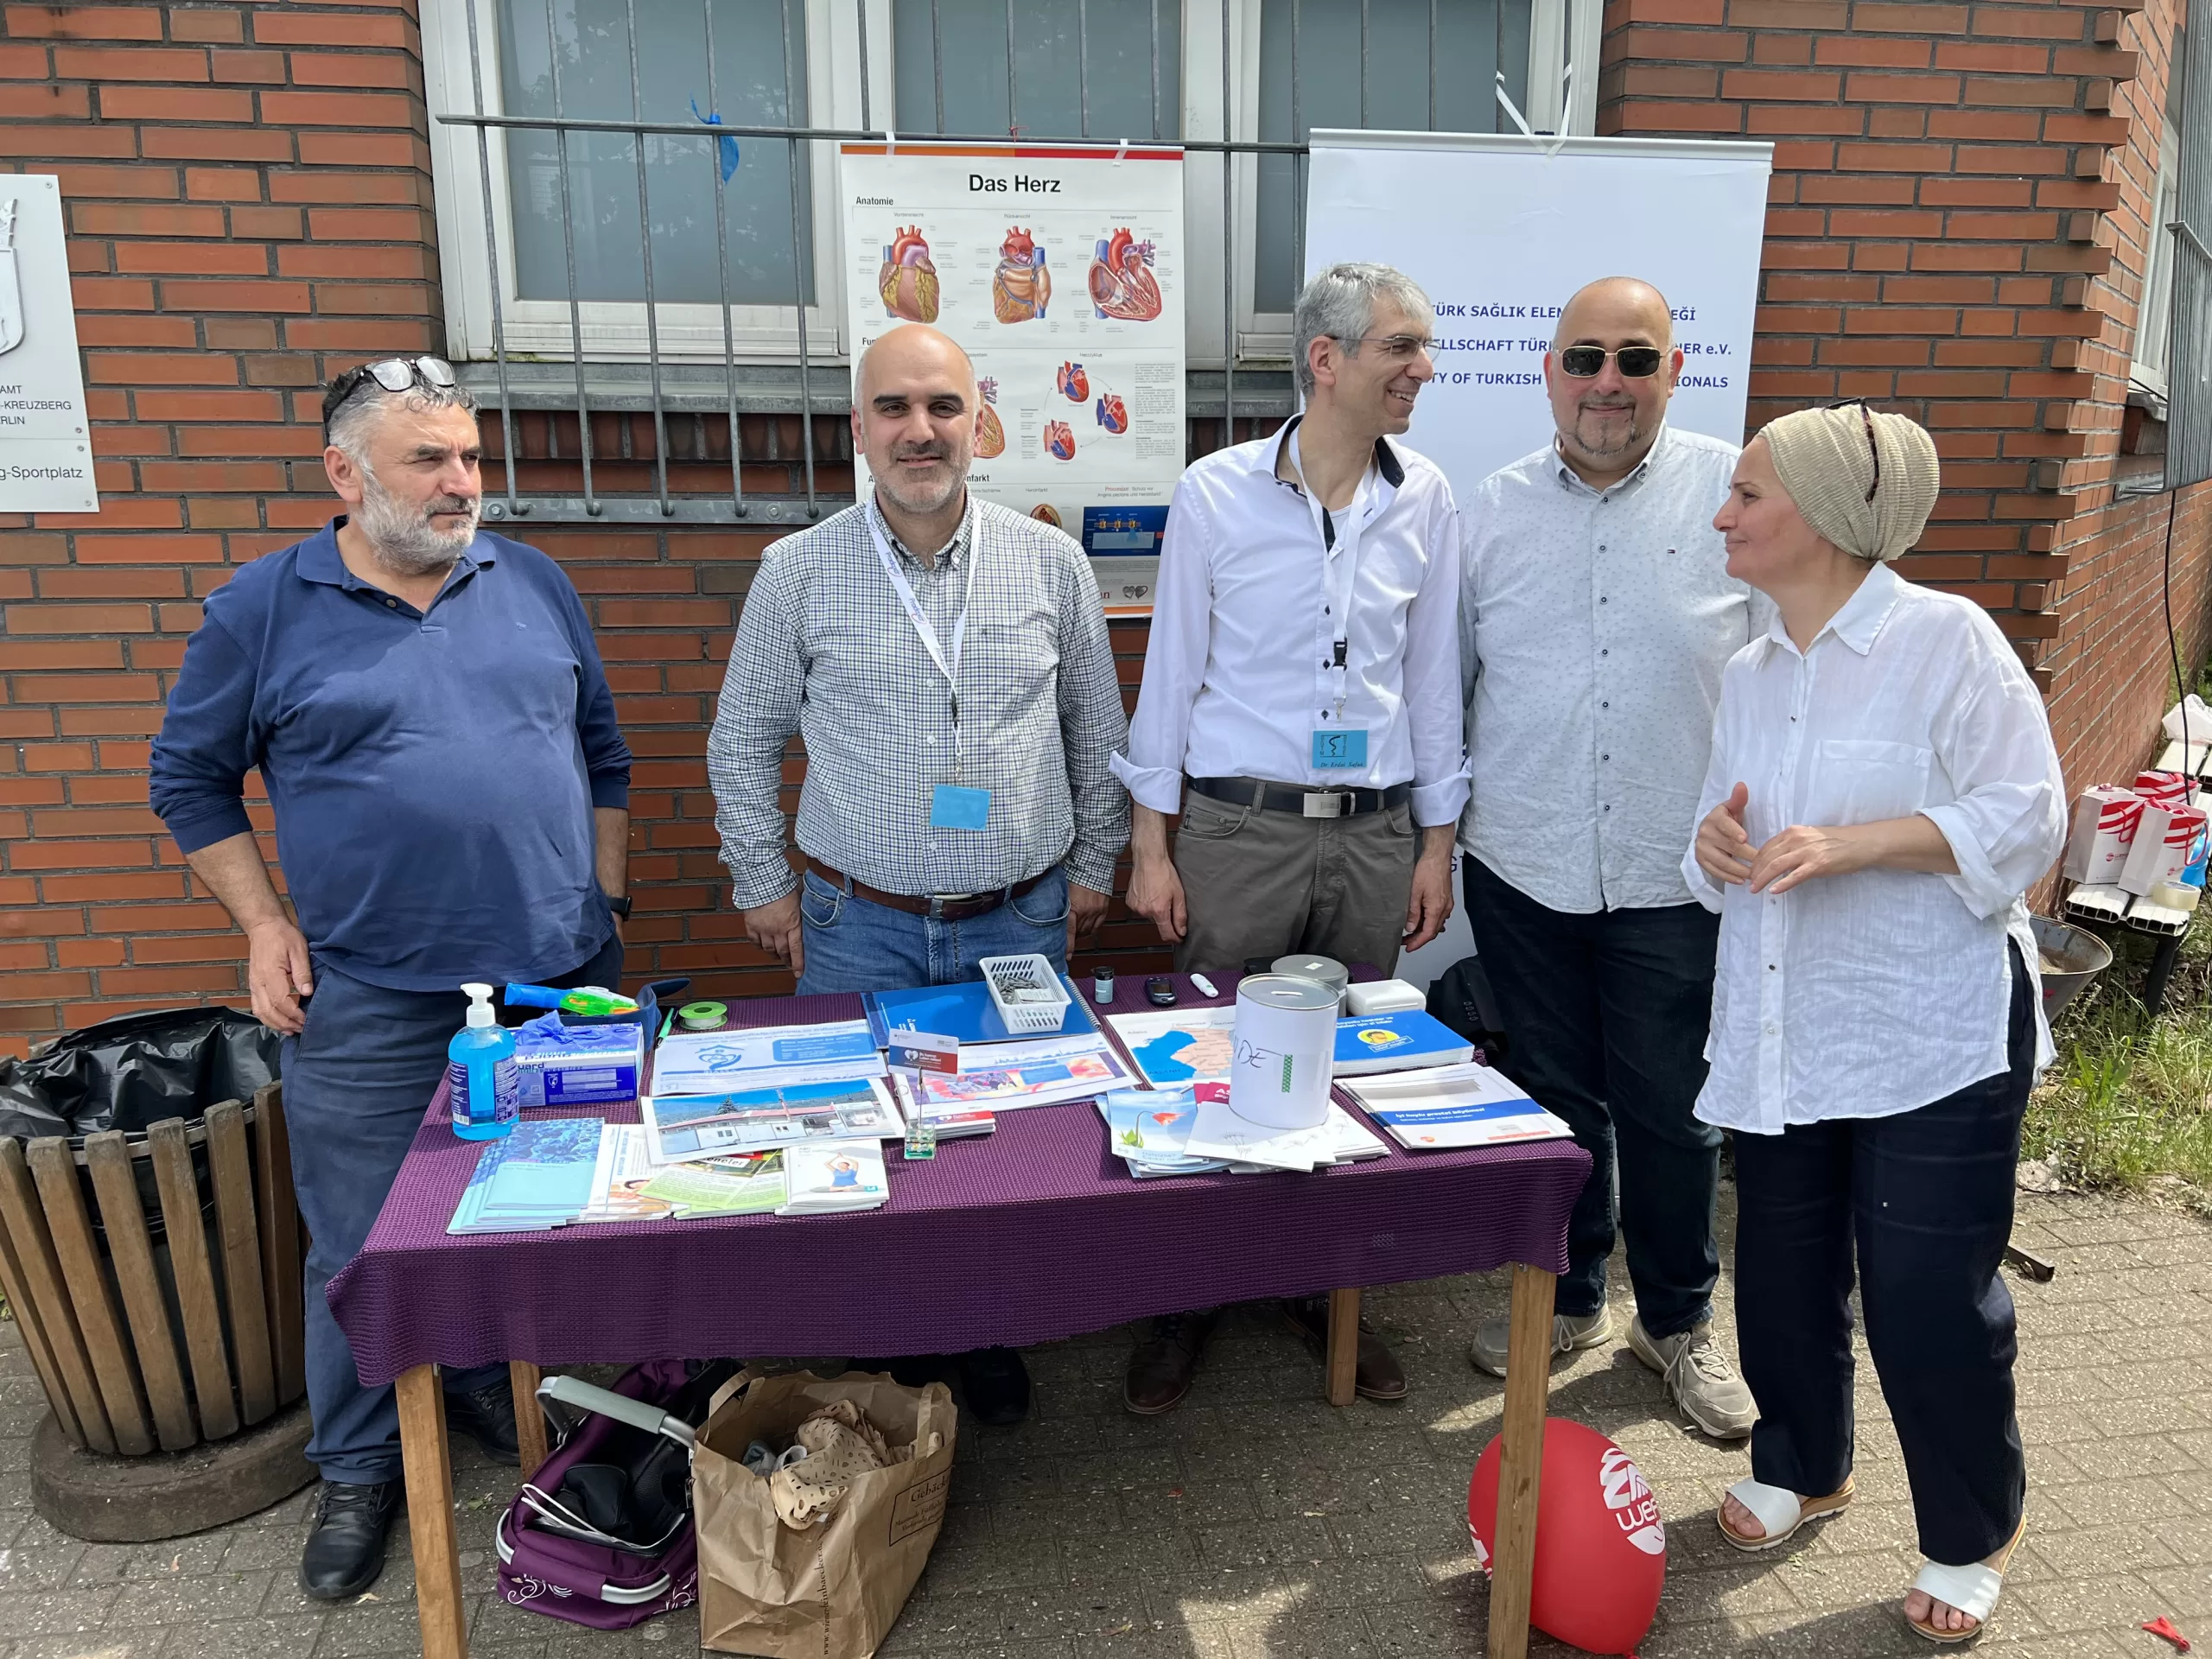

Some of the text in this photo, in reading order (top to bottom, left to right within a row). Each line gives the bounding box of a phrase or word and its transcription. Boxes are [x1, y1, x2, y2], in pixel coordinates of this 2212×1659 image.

[969, 174, 1061, 193] Das Herz
[855, 196, 894, 206] Anatomie
[1470, 302, 1526, 318] SAĞLIK
[1706, 344, 1732, 355] e.V.
[1452, 373, 1471, 384] OF
[1476, 373, 1542, 385] TURKISH
[0, 401, 72, 410] -KREUZBERG
[0, 416, 25, 425] RLIN
